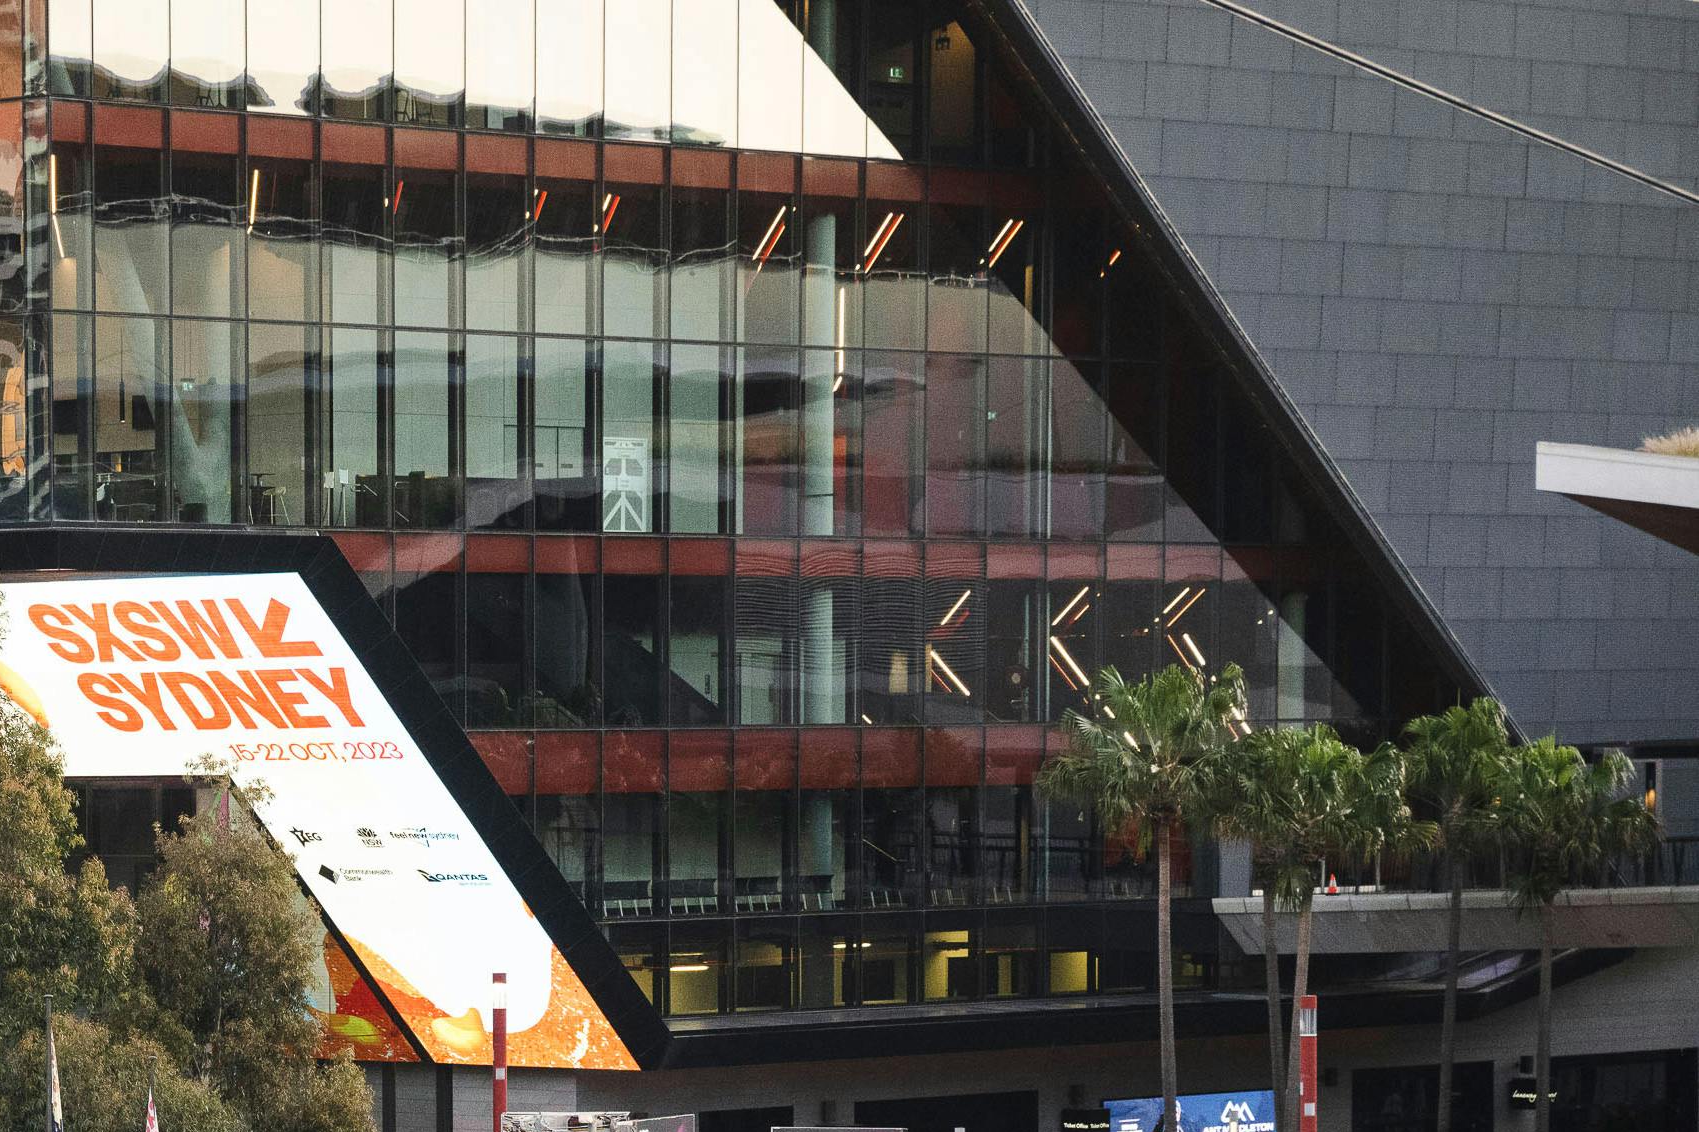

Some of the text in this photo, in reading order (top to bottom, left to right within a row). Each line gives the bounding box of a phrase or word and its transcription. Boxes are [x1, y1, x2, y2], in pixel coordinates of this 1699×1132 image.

[27, 598, 244, 664] SXSW
[76, 667, 366, 732] SYDNEY
[228, 743, 289, 762] 15-22
[342, 741, 404, 761] 2023
[434, 872, 488, 882] QANTAS
